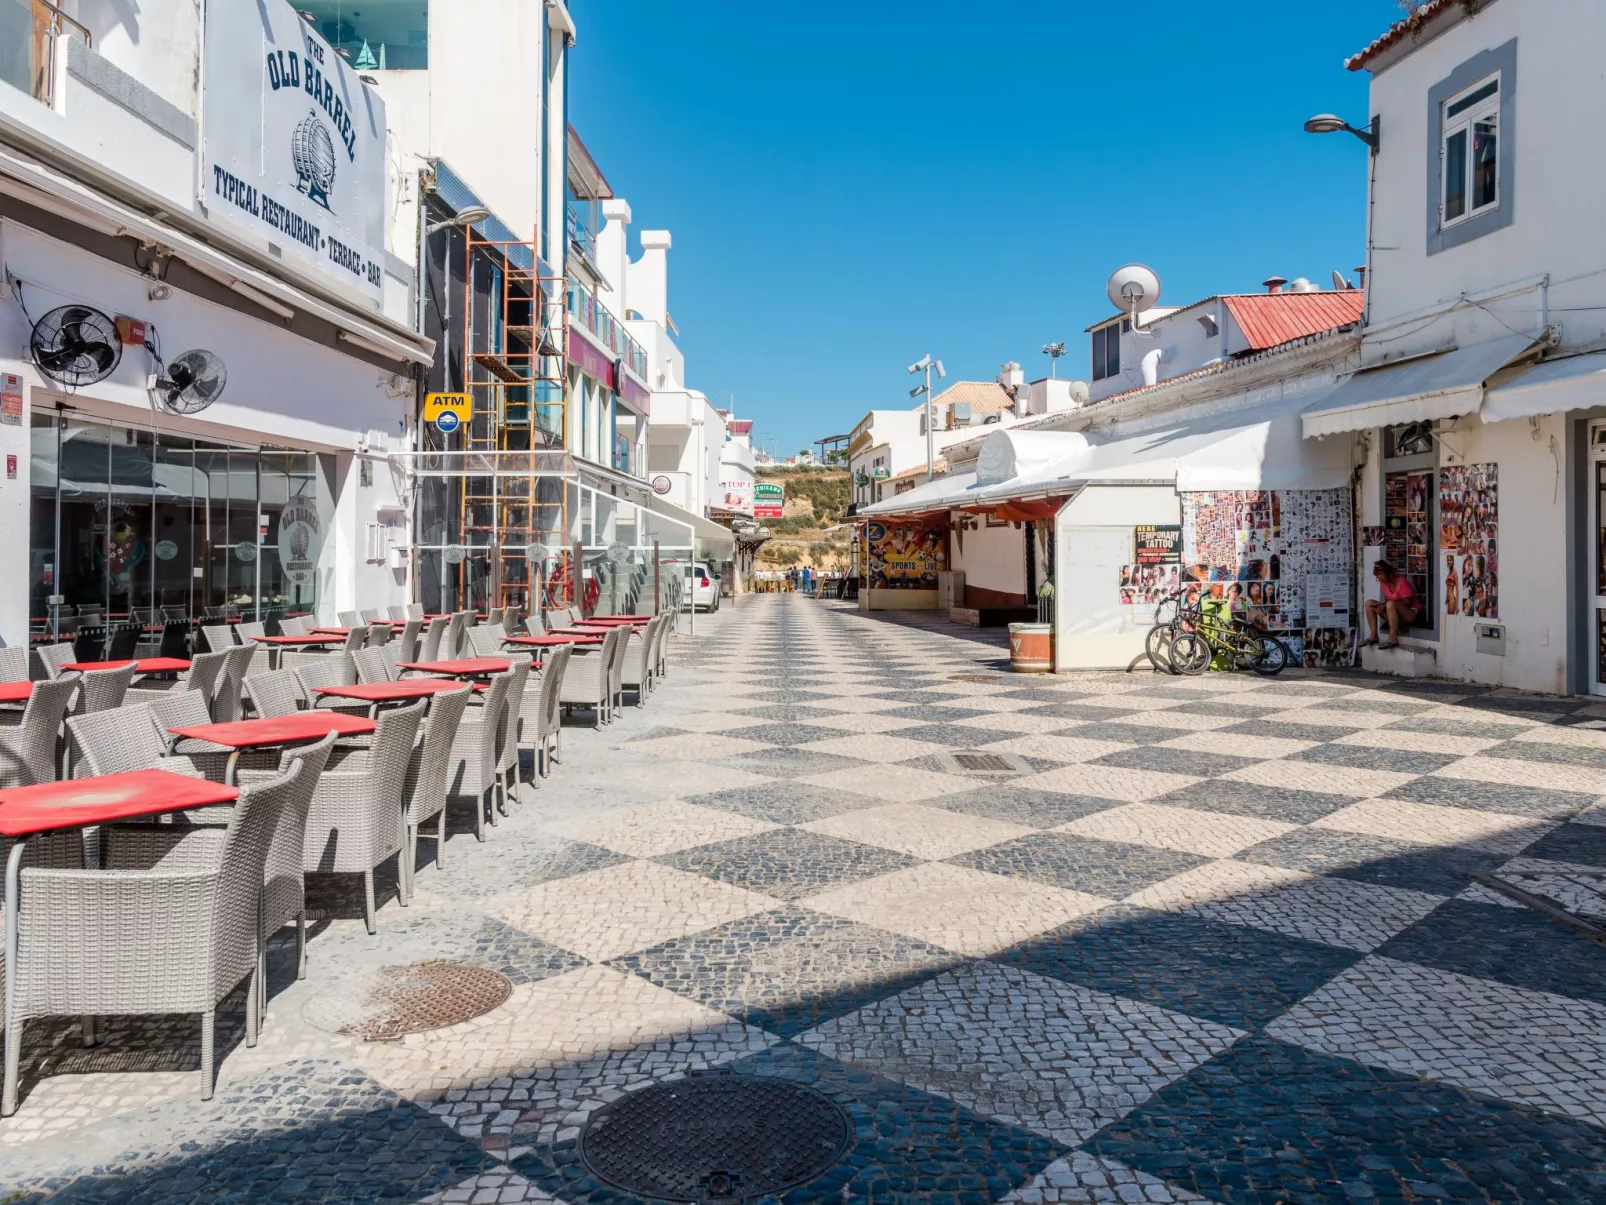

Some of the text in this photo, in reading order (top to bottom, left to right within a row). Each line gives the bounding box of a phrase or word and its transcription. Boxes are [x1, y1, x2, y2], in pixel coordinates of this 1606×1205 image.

[308, 34, 324, 65] THE
[267, 50, 356, 163] OLD BARREL
[214, 164, 381, 288] TYPICAL RESTAURANT TERRACE BAR
[433, 397, 464, 405] ATM
[282, 508, 319, 534] OLD BARREL
[1137, 531, 1179, 542] TEMPORARY
[1146, 539, 1173, 548] TATTOO
